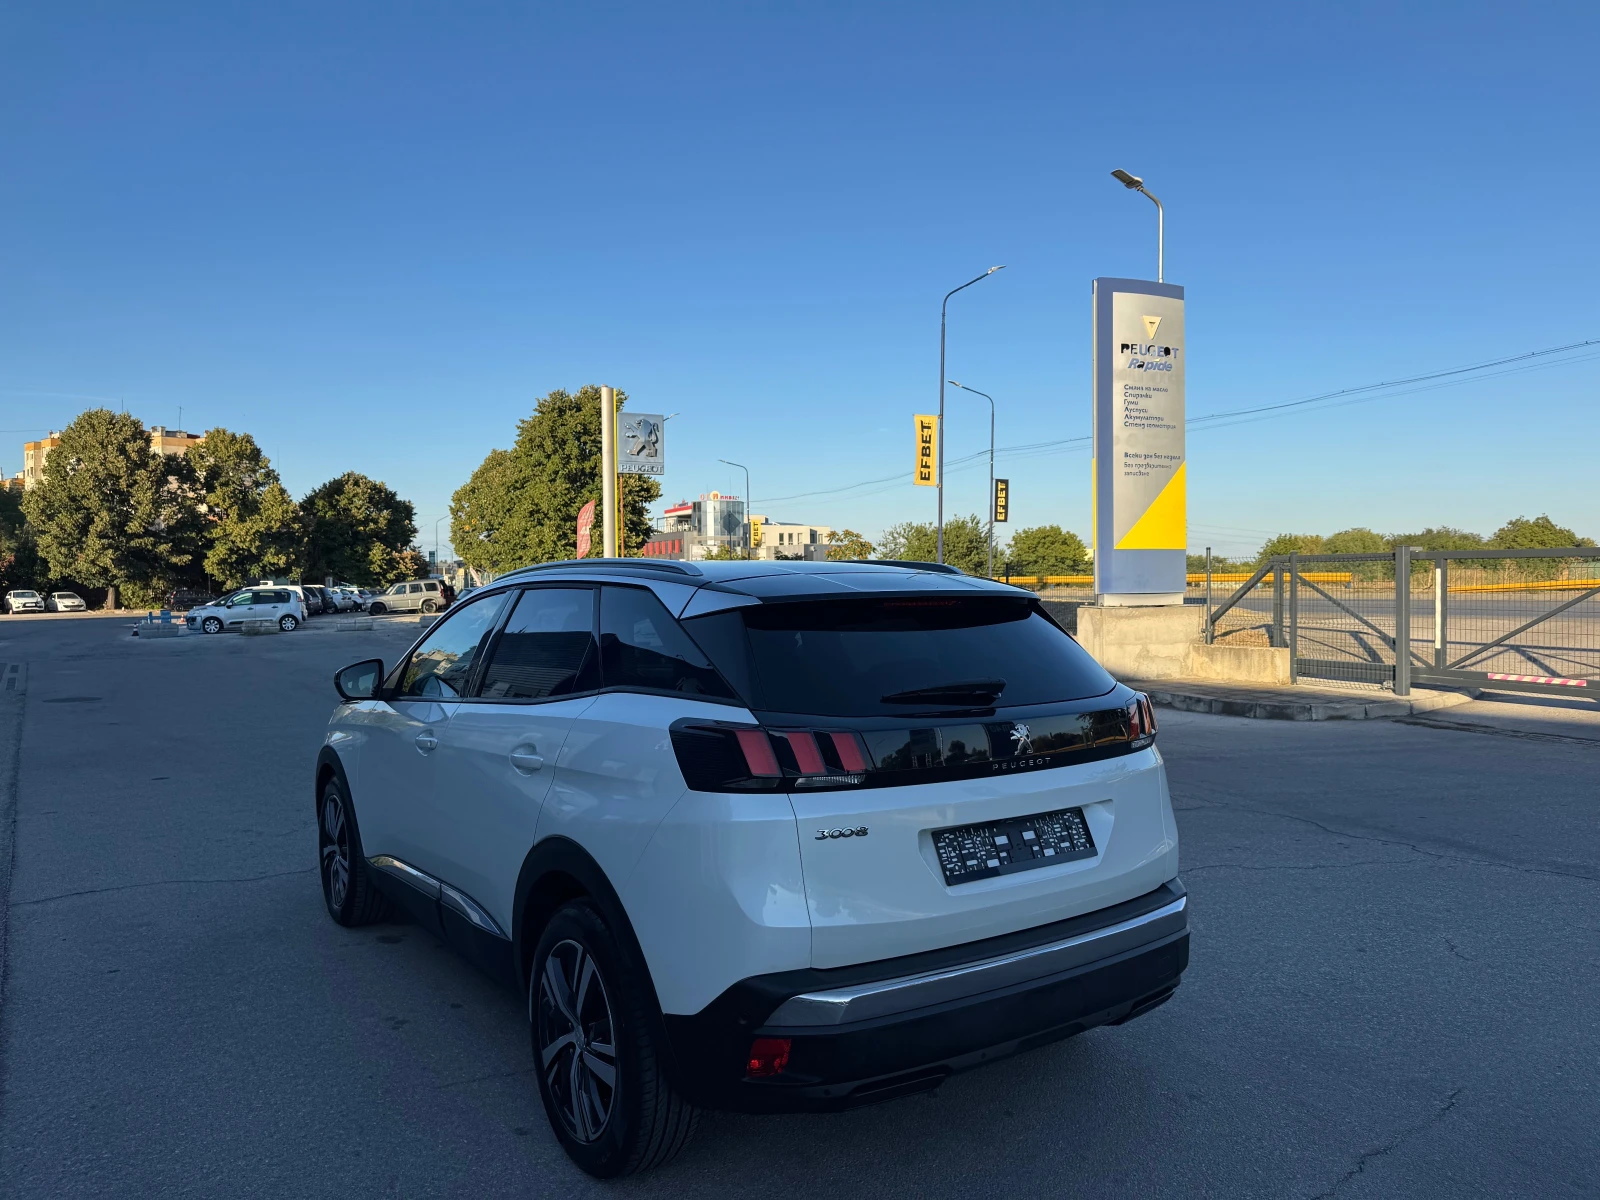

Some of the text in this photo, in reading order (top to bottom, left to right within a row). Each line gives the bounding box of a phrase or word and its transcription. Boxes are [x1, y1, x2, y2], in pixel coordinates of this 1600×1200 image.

[1120, 343, 1179, 359] PEUGEOT
[1127, 358, 1173, 372] Rapide
[920, 420, 932, 481] EFBET
[620, 464, 664, 473] PEUGEOT
[997, 481, 1006, 520] EFBET
[992, 757, 1051, 771] PEUGEOT
[814, 826, 869, 840] 3008
